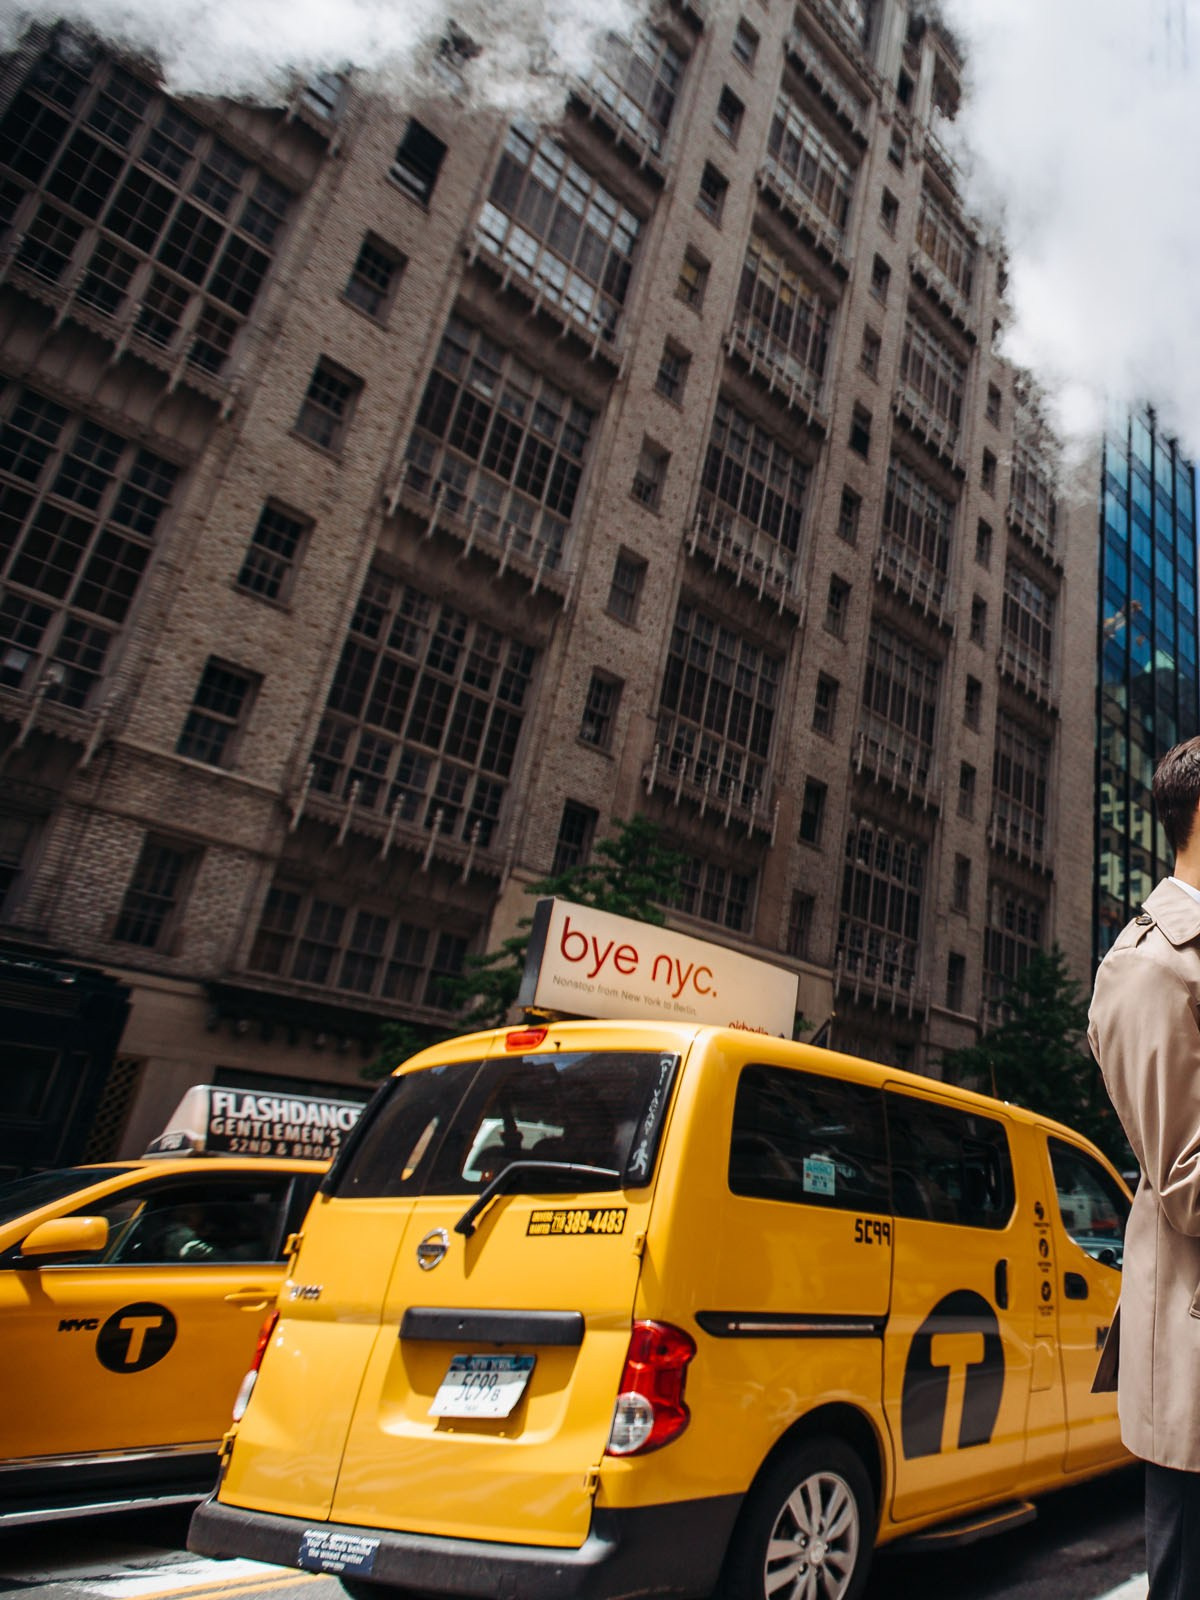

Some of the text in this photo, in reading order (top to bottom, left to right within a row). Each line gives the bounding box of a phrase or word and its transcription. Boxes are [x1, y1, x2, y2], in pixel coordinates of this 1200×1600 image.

[560, 916, 717, 998] bye nyc.
[552, 975, 595, 993] Nonstop
[597, 983, 618, 997] from
[620, 989, 641, 1002] New
[643, 995, 661, 1006] York
[663, 1000, 672, 1010] to
[210, 1117, 342, 1146] GENTLEMEN'S
[275, 1141, 288, 1156] &
[58, 1318, 99, 1332] NYC
[119, 1315, 163, 1364] T
[930, 1331, 985, 1454] T
